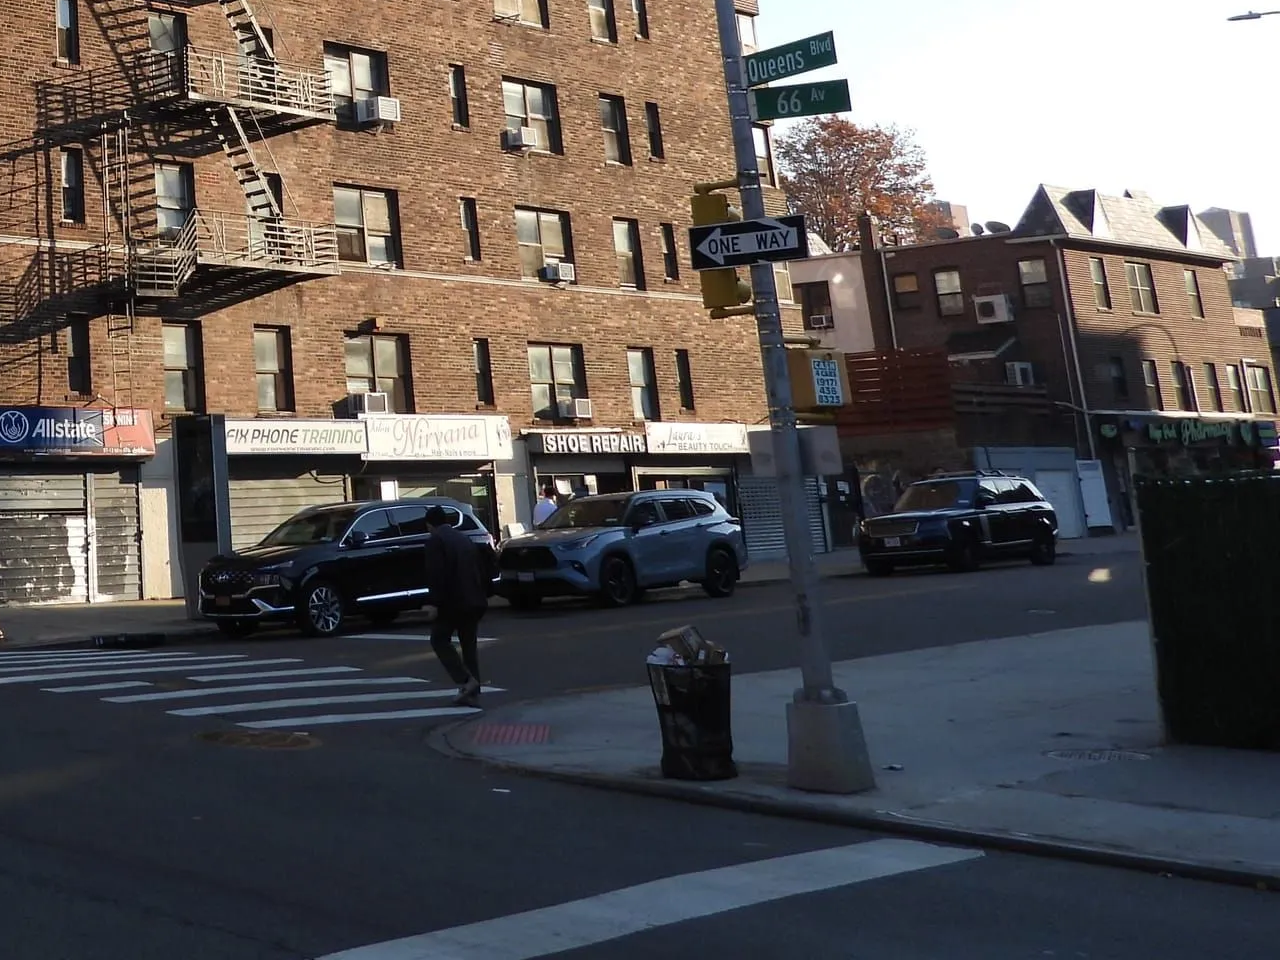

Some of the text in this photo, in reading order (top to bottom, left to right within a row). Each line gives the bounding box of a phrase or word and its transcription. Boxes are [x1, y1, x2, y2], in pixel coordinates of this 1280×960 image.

[748, 38, 832, 82] Queens Blvd
[777, 87, 826, 114] 66 Av
[708, 230, 790, 255] ONE WAY
[813, 360, 837, 371] CASH
[816, 378, 837, 387] (917)
[32, 418, 96, 439] Allstate
[227, 428, 363, 444] FIX PHONE TRAINING
[393, 418, 481, 456] Nirvana
[546, 435, 642, 452] SHOE REPAIR
[678, 442, 733, 451] BEAUTY TOUCH
